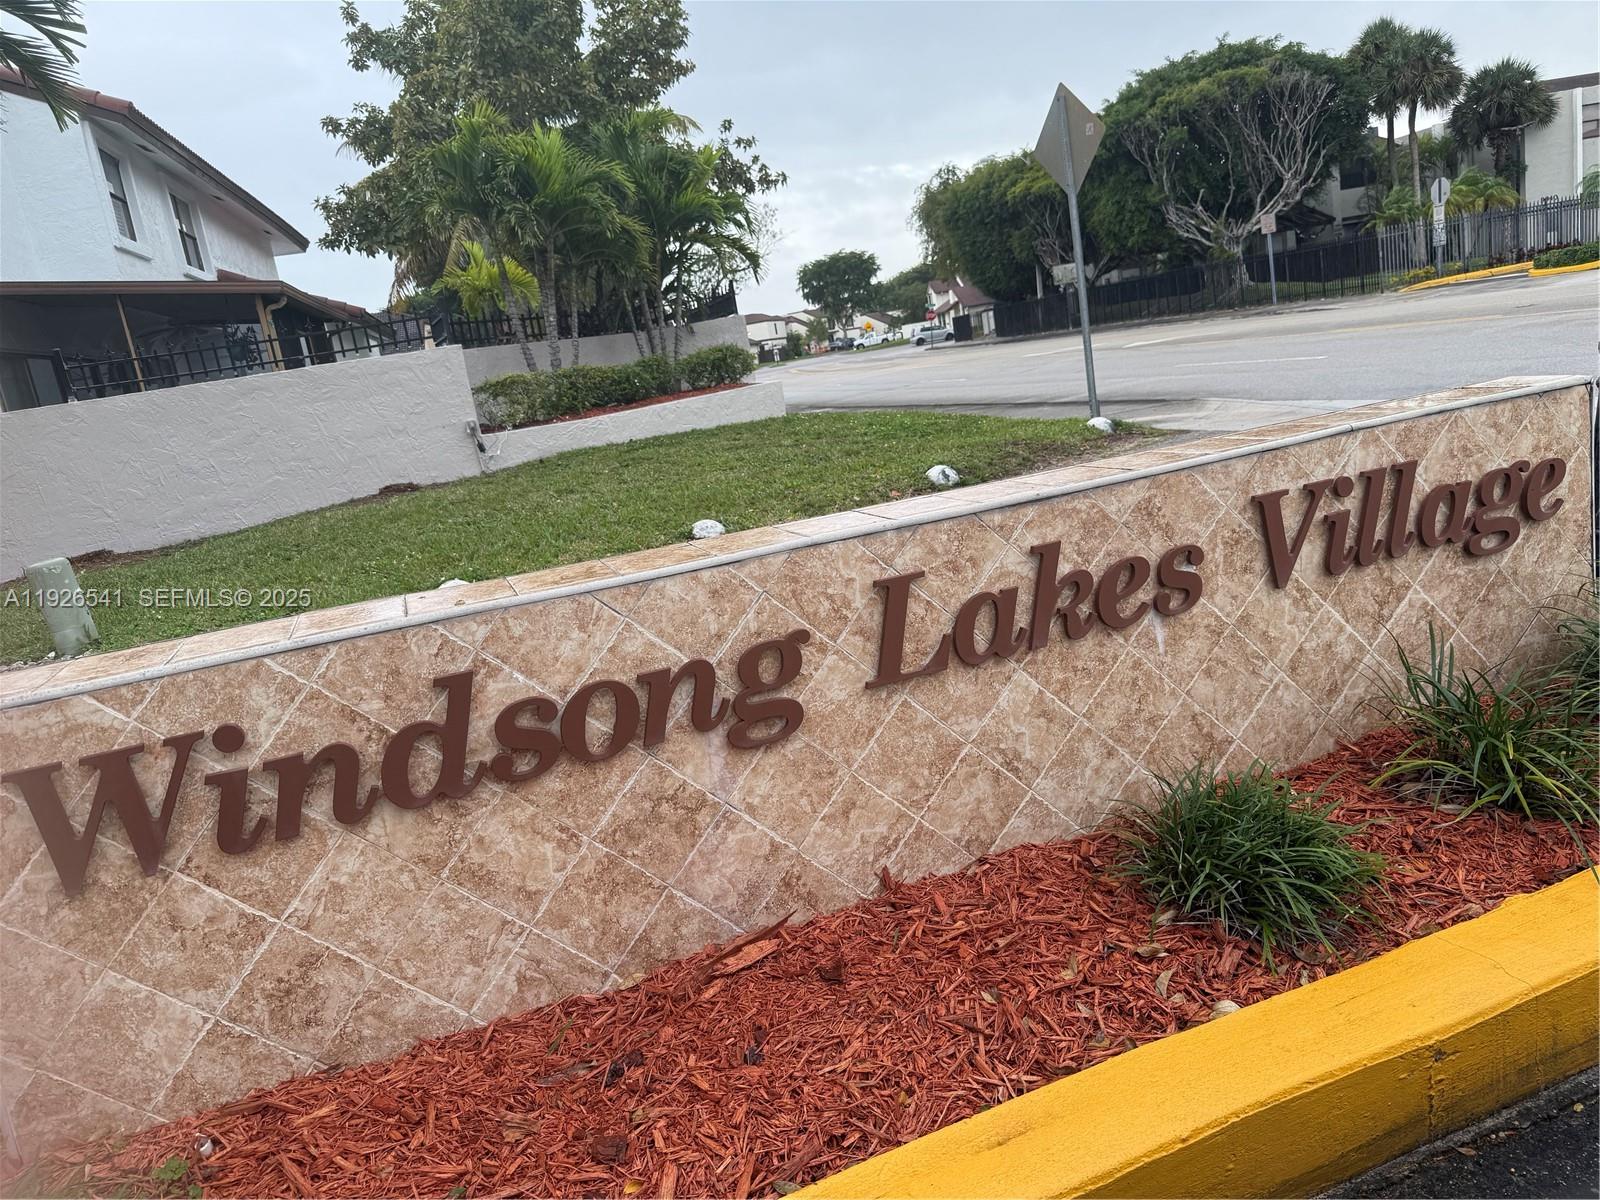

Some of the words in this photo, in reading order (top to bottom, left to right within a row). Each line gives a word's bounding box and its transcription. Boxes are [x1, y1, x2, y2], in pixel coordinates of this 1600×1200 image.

[1, 628, 811, 898] Windsong
[865, 540, 1205, 689] Lakes
[1251, 457, 1568, 589] Village
